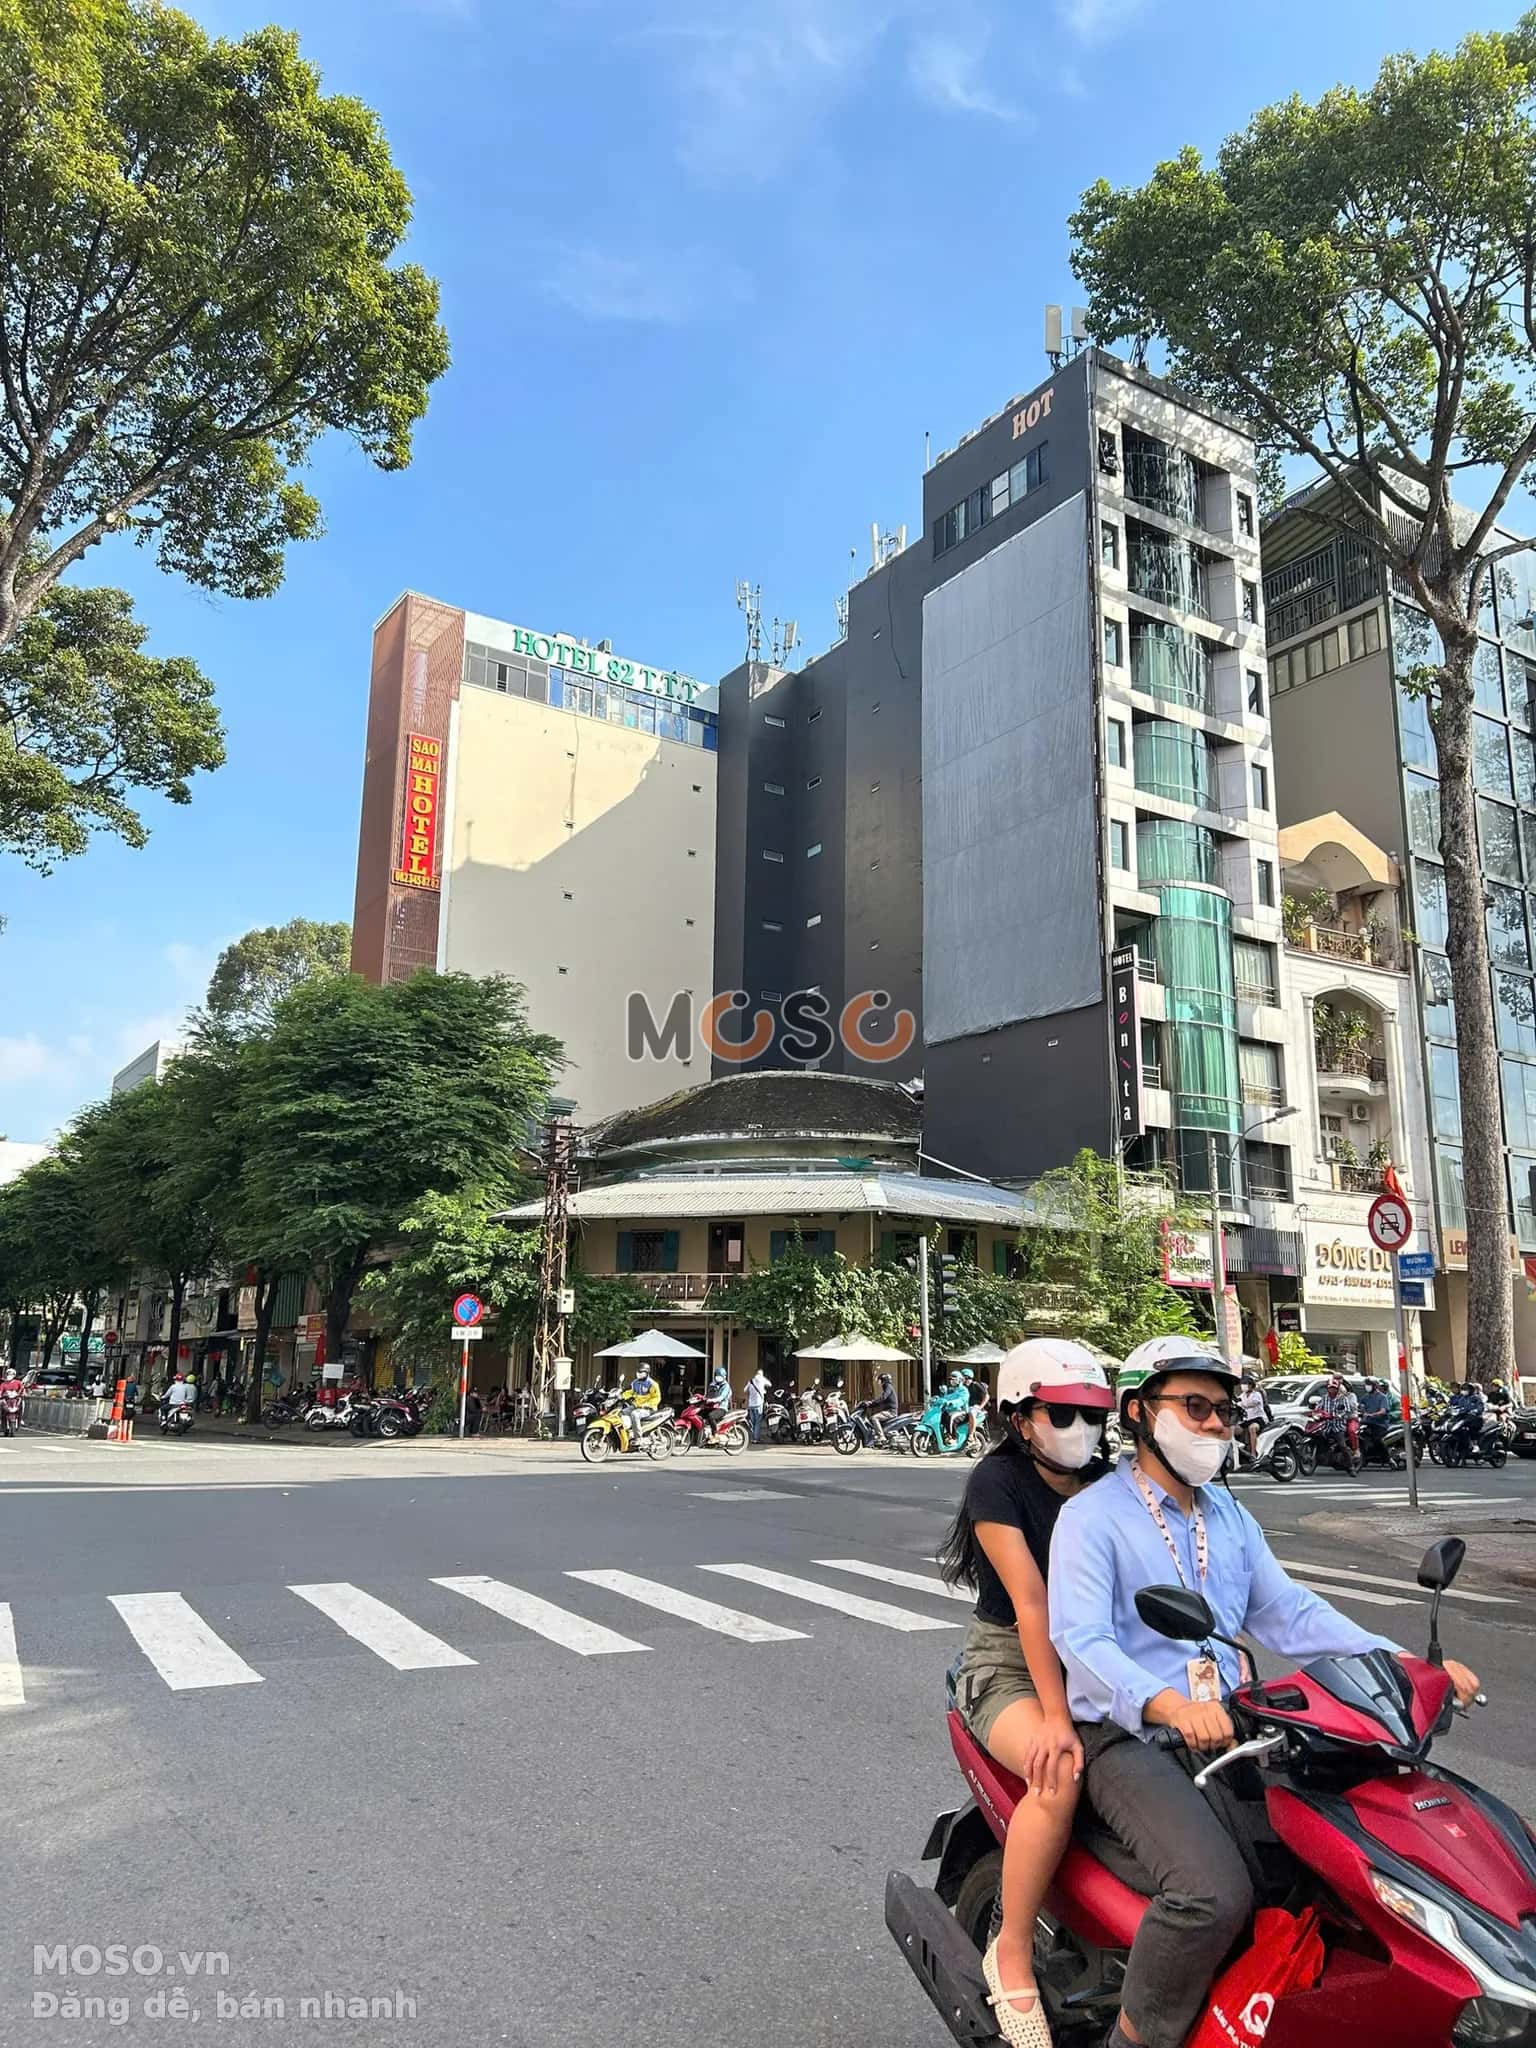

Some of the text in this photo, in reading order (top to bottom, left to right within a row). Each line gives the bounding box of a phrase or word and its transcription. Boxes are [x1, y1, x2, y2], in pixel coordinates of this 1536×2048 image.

[1012, 388, 1055, 440] HOT
[513, 628, 603, 676] HOTEL
[607, 658, 635, 686] 82
[412, 738, 438, 756] SAO
[411, 756, 437, 774] MAI
[410, 774, 433, 876] HOTEL
[1113, 952, 1134, 968] HOTEL
